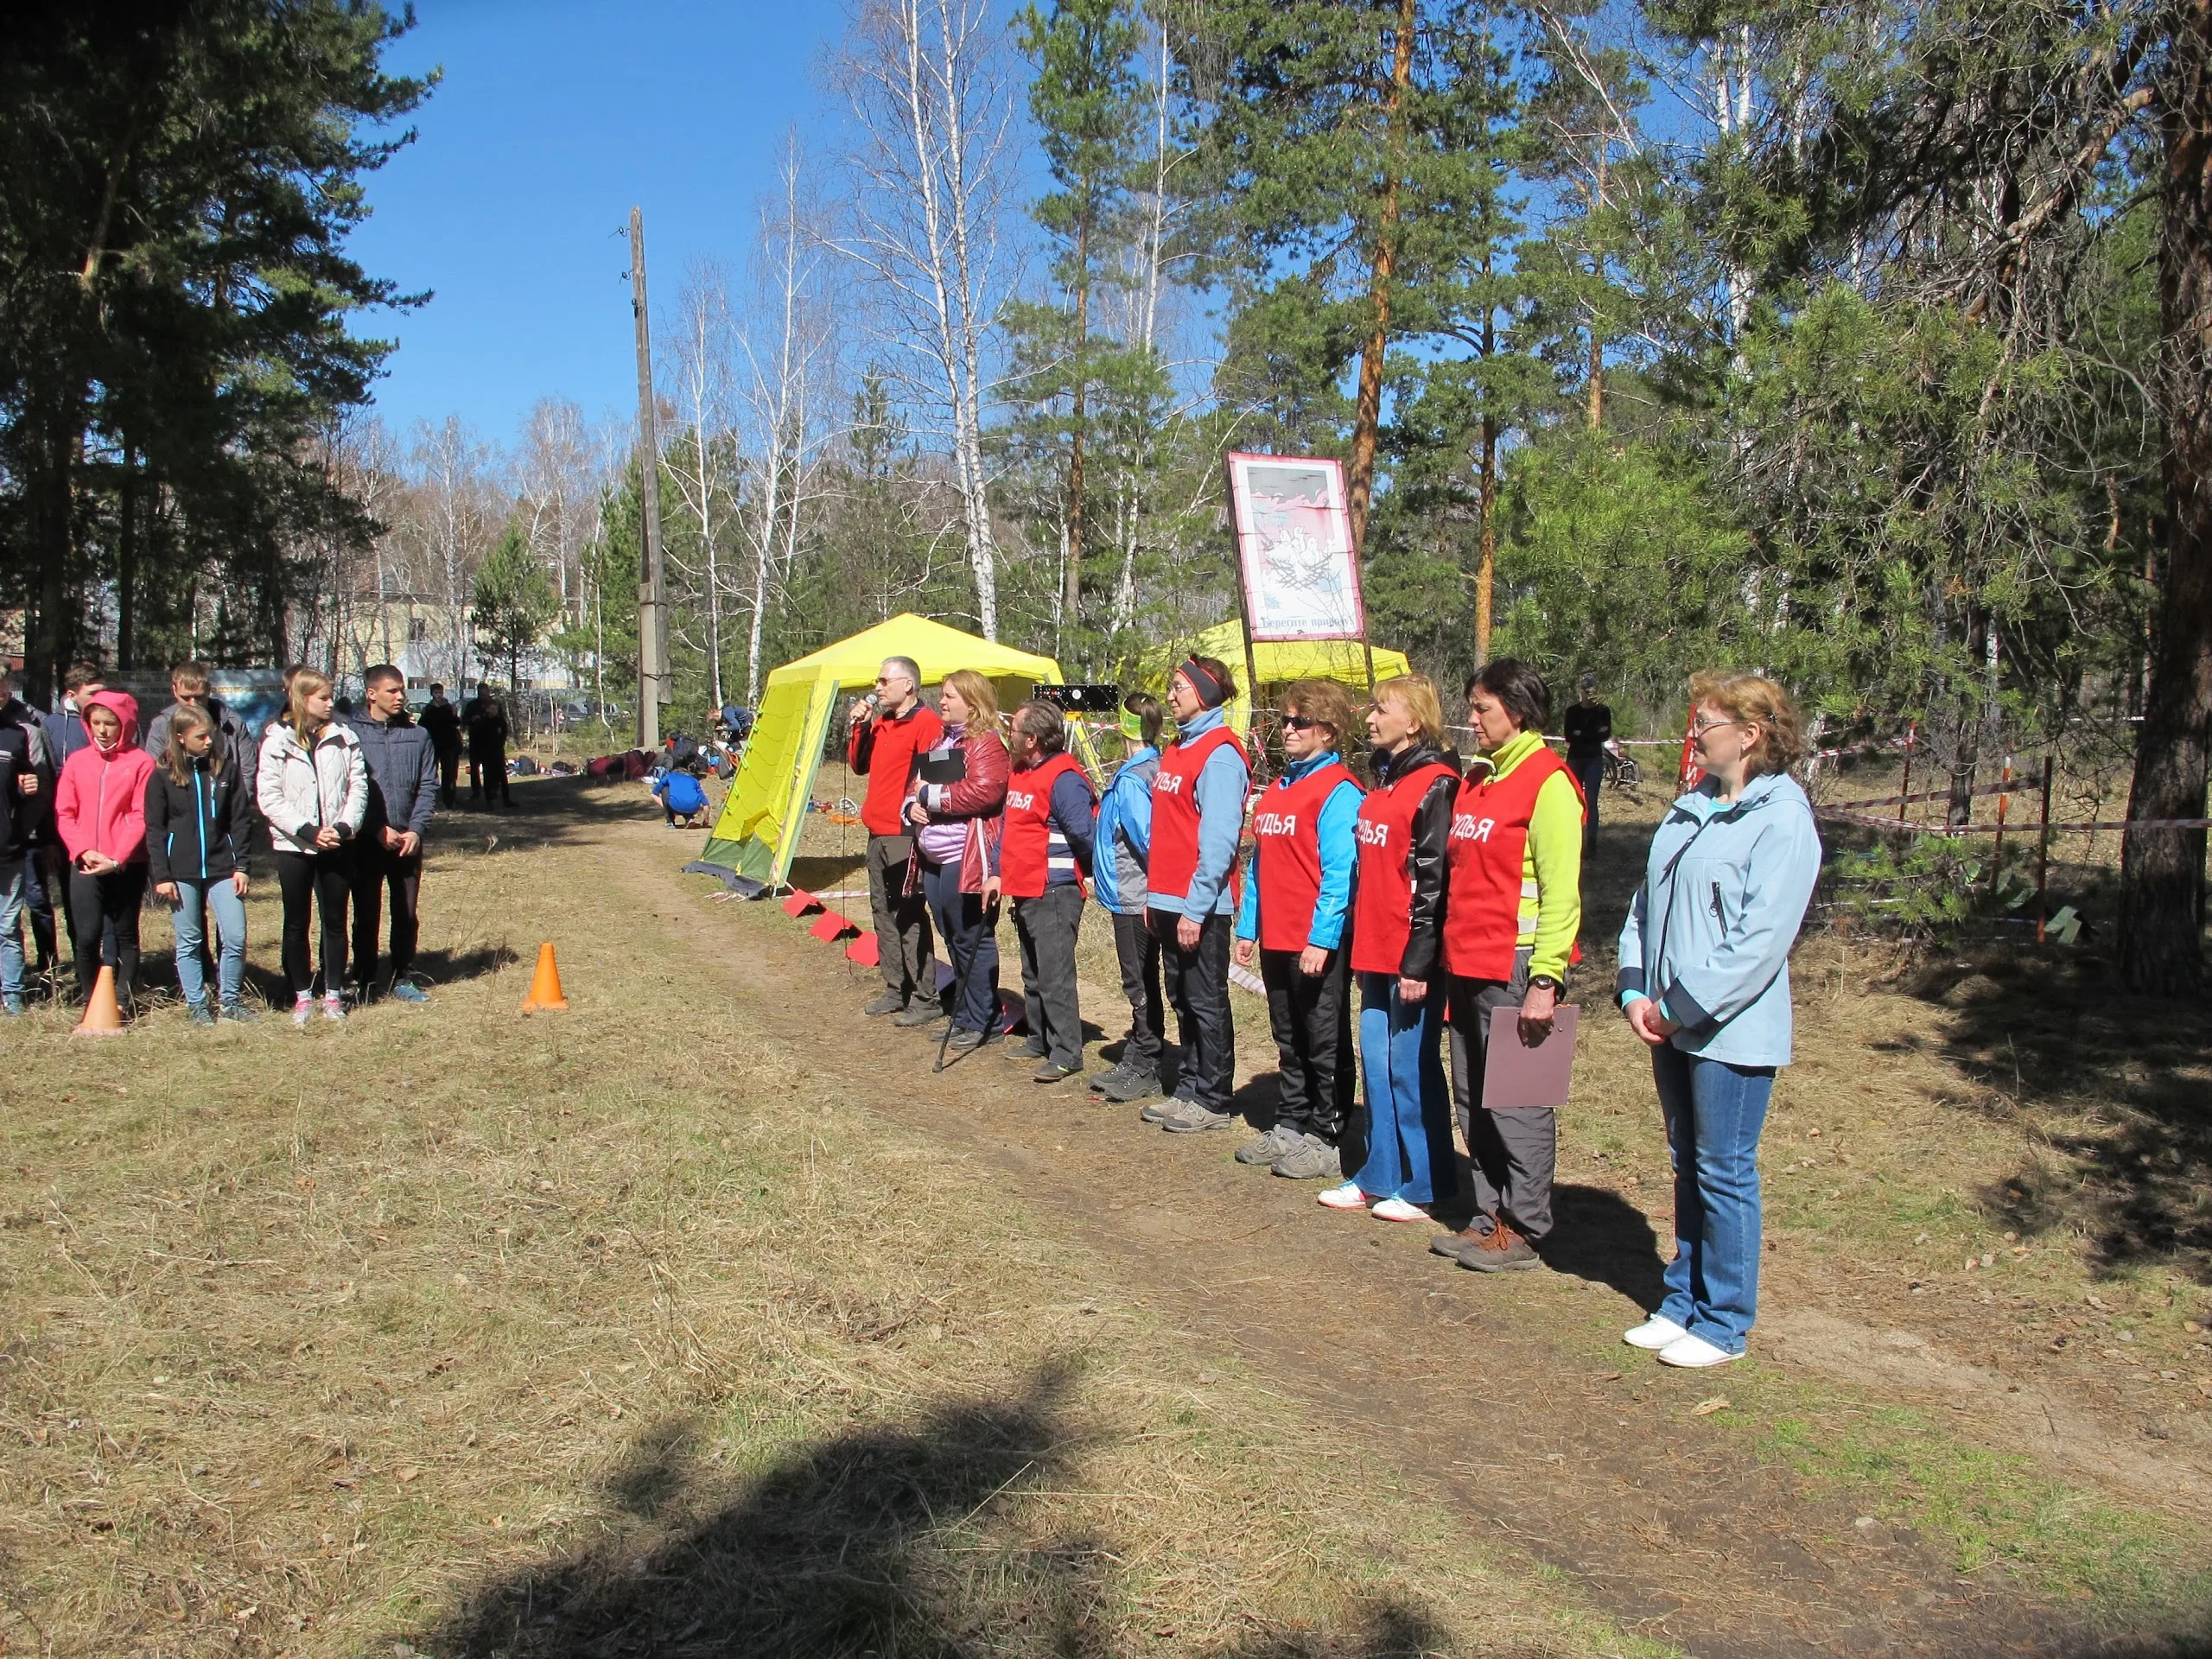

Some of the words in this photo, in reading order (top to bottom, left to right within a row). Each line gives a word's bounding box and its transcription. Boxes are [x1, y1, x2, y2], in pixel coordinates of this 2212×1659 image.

[1262, 617, 1307, 629] Берегите
[1153, 772, 1183, 795] УДЬЯ
[1254, 812, 1297, 836] СУДЬЯ
[1449, 813, 1496, 843] УДЬЯ
